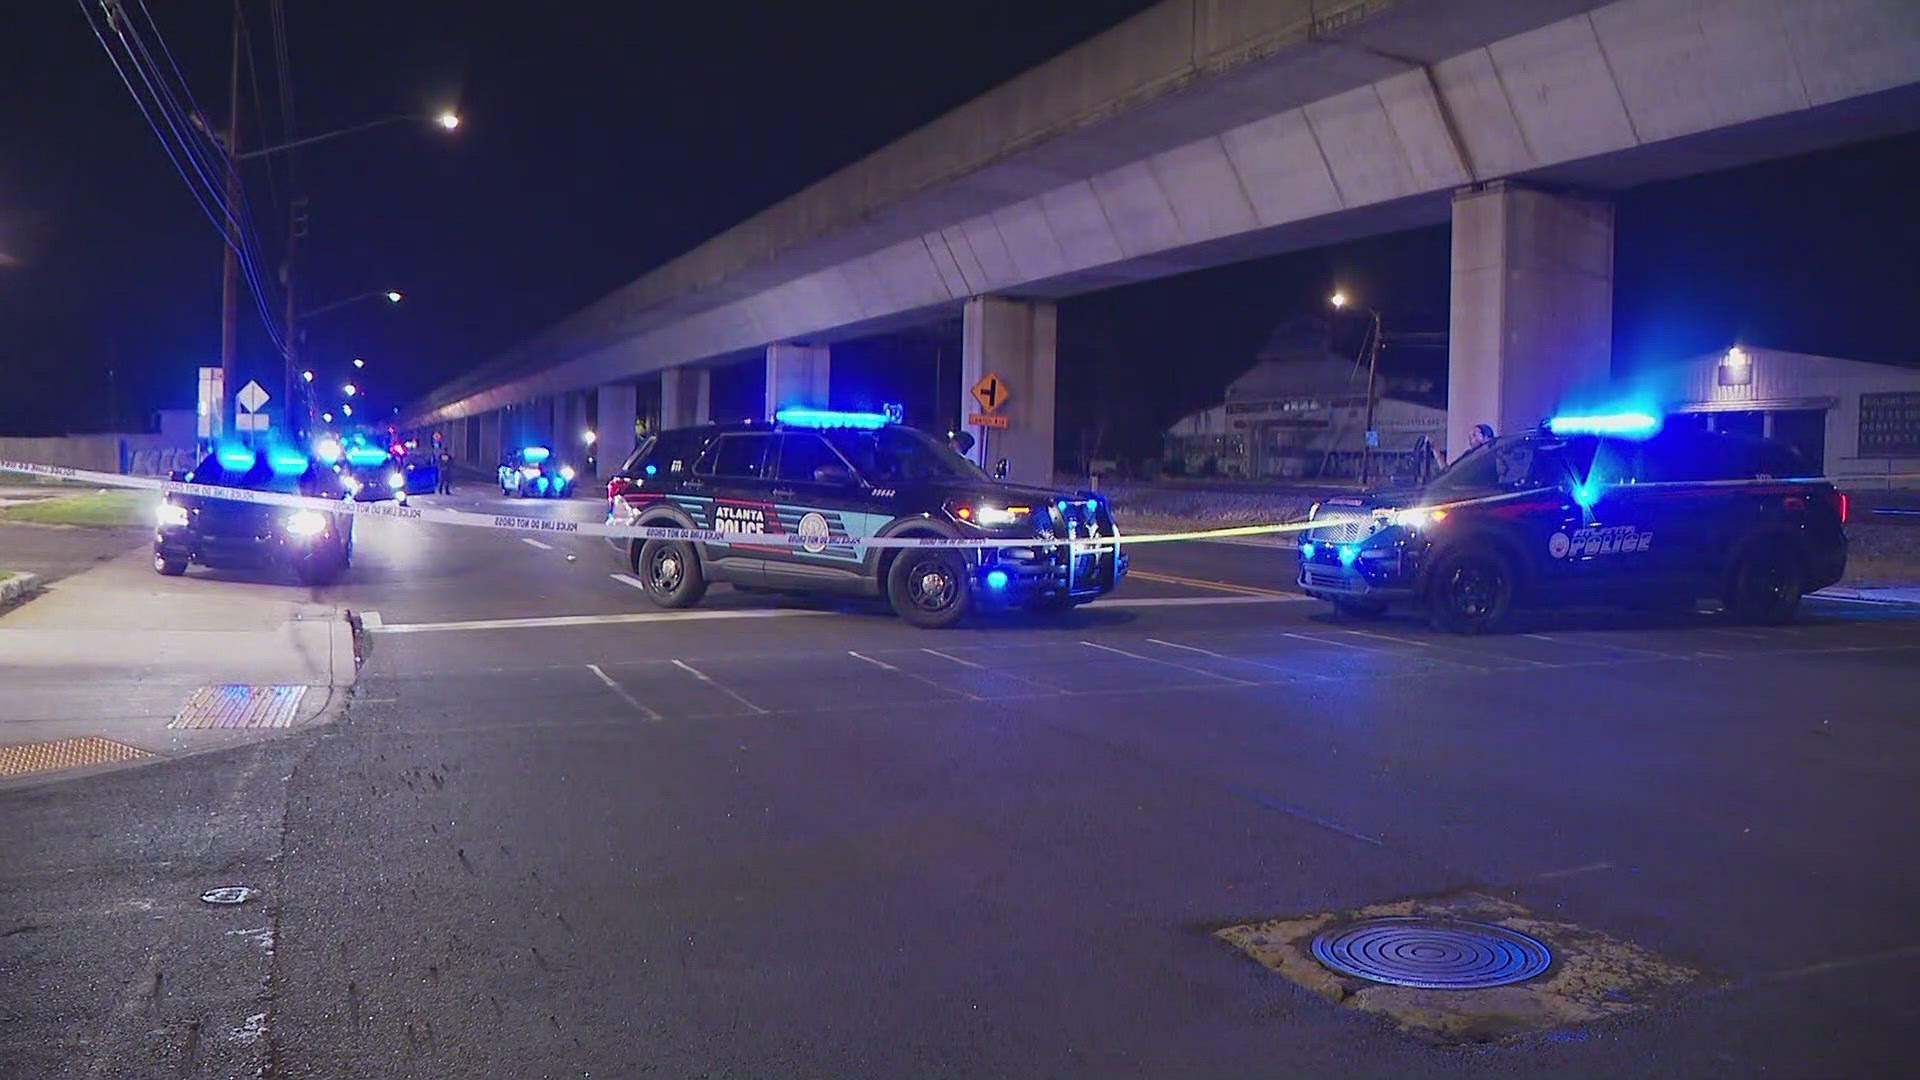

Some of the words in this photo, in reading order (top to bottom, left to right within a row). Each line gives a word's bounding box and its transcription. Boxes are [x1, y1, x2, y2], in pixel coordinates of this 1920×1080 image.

[715, 506, 765, 523] ATLANTA
[715, 518, 765, 535] POLICE
[1567, 531, 1654, 557] POLICE
